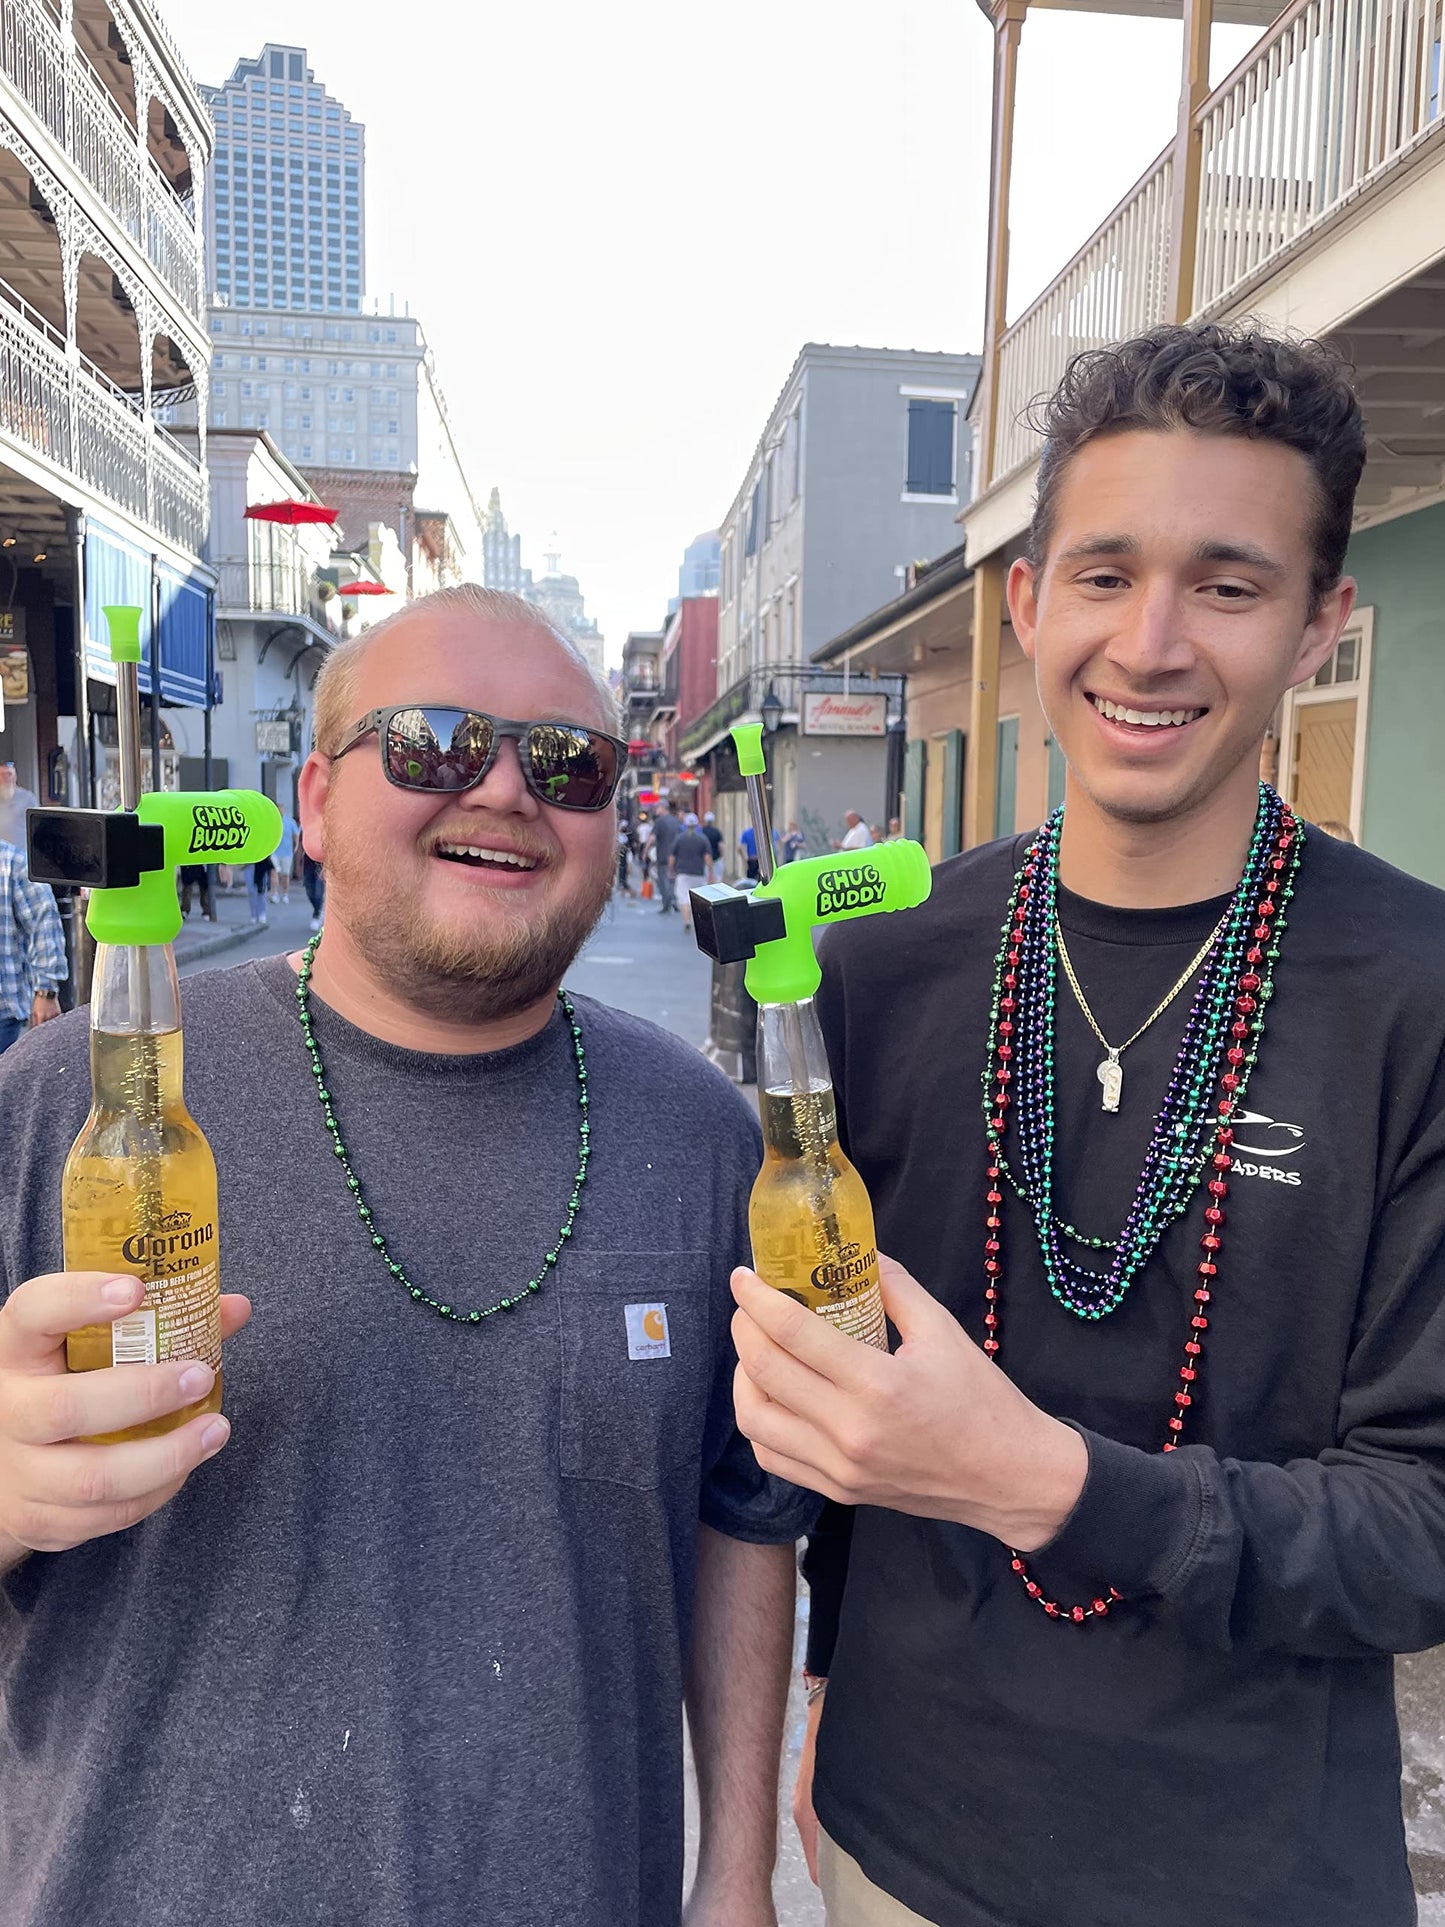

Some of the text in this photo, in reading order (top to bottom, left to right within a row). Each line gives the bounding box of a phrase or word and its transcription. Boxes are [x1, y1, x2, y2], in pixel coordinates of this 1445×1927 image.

[194, 806, 244, 827] CHUG
[190, 826, 250, 851] BUDDY
[819, 865, 879, 891] CHUG
[818, 882, 885, 914] BUDDY
[1230, 1159, 1302, 1186] ADERS
[122, 1223, 213, 1266] Corona
[153, 1256, 199, 1276] Extra
[811, 1248, 876, 1290] Corona
[144, 1280, 168, 1292] ORTED
[169, 1277, 185, 1287] BEER
[837, 1278, 870, 1298] Extra
